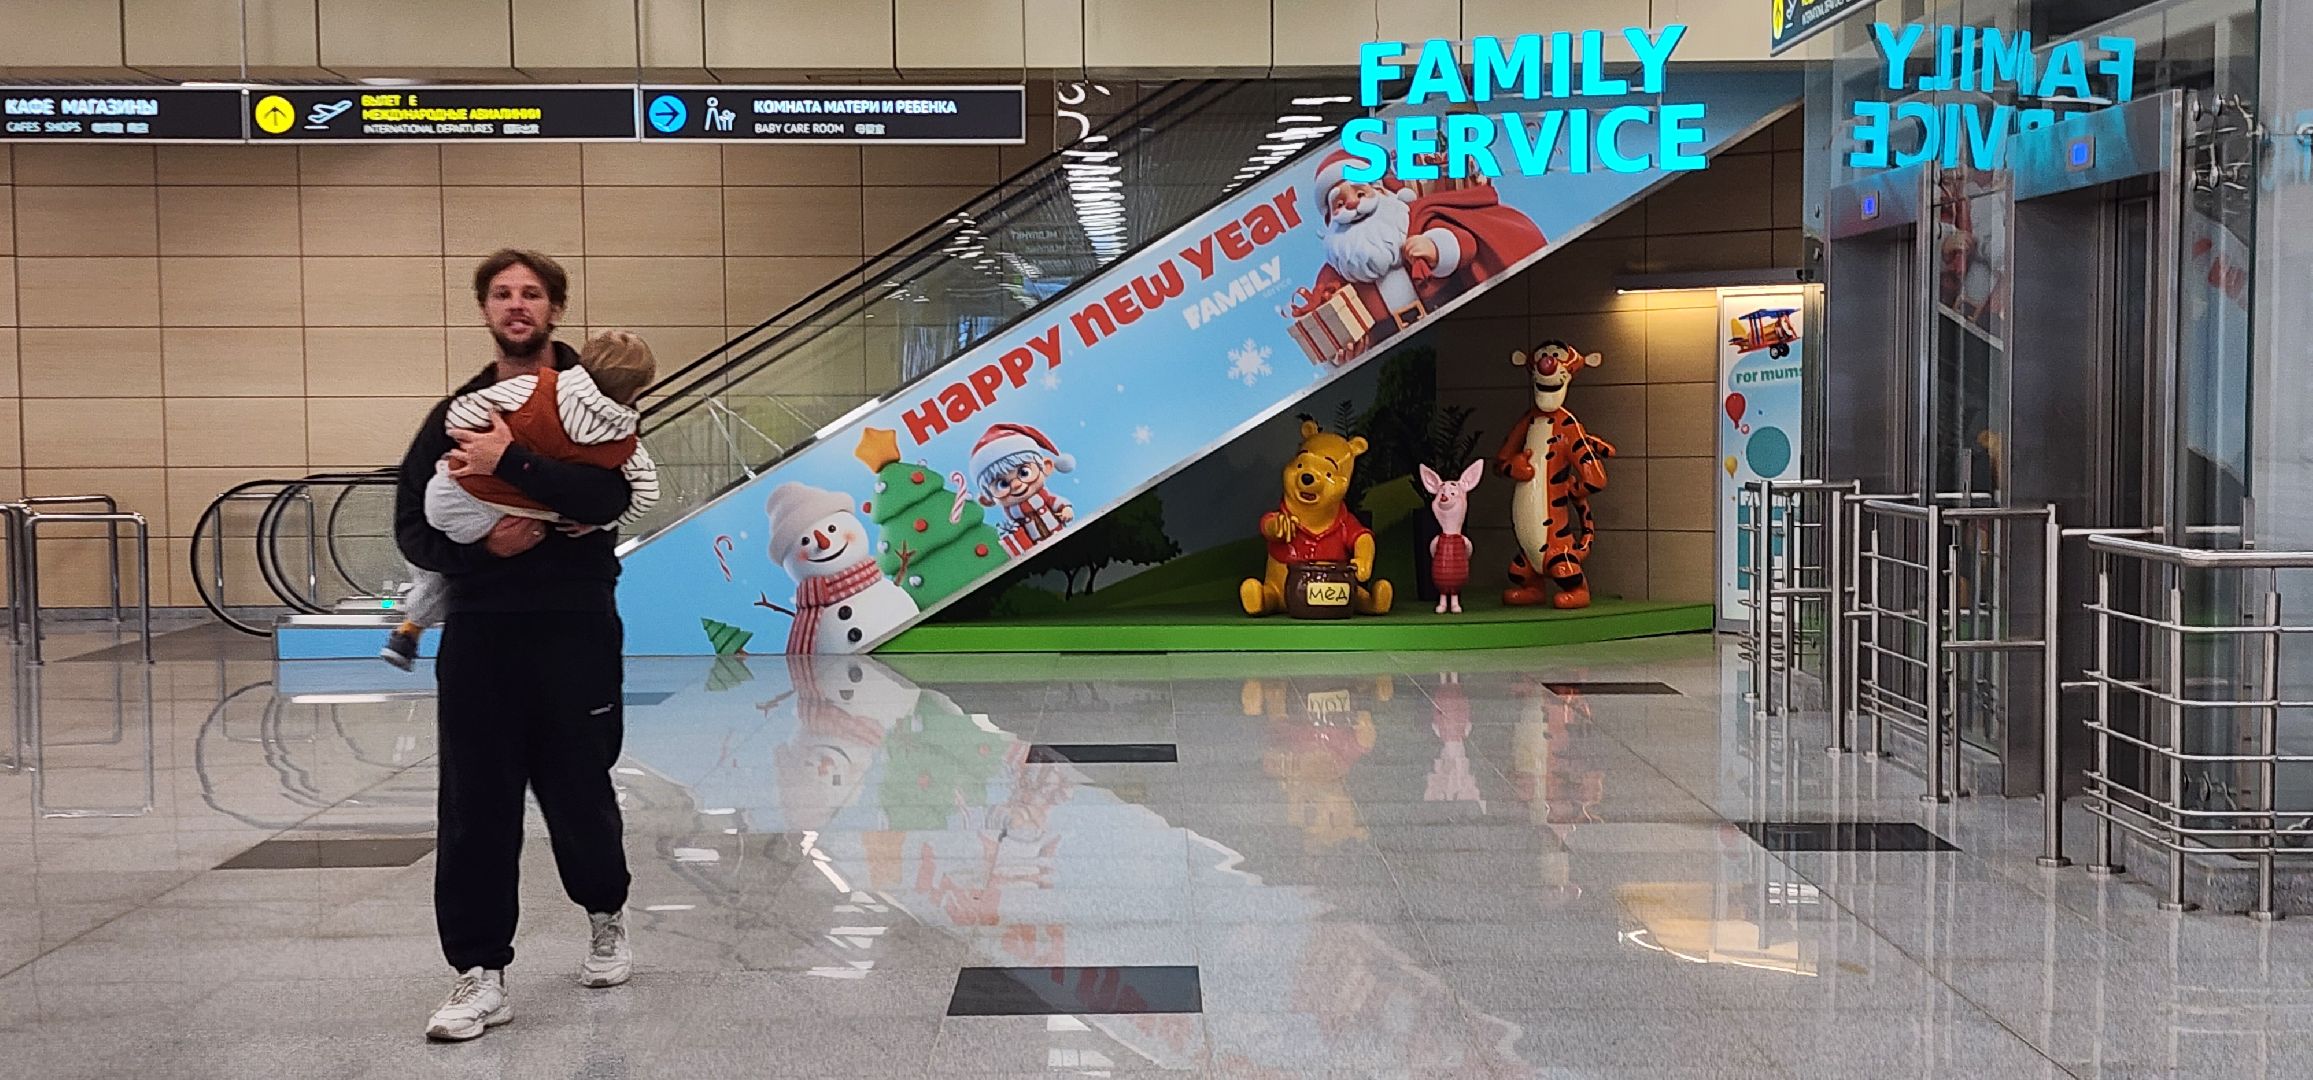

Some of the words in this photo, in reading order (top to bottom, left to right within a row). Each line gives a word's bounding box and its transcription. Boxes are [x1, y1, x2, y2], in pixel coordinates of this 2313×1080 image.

[1360, 24, 1688, 107] FAMILY
[5, 98, 56, 115] КАФЕ
[60, 98, 158, 115] МАГАЗИНЫ
[361, 94, 401, 106] ВЫЛЕТ
[754, 100, 822, 113] КОМНАТА
[823, 100, 880, 113] МАТЕРИ
[882, 100, 893, 113] И
[896, 100, 958, 113] РЕБЕНКА
[362, 108, 468, 121] МЕЖДУНАРОДНЫЕ
[469, 108, 541, 120] АВИАЛИНИИ
[363, 123, 436, 134] INTERNATIONAL
[436, 123, 494, 134] DEPARTURES
[754, 123, 782, 133] BABY
[784, 123, 811, 133] CARE
[812, 123, 845, 133] ROOM
[1340, 102, 1710, 183] SERVICE
